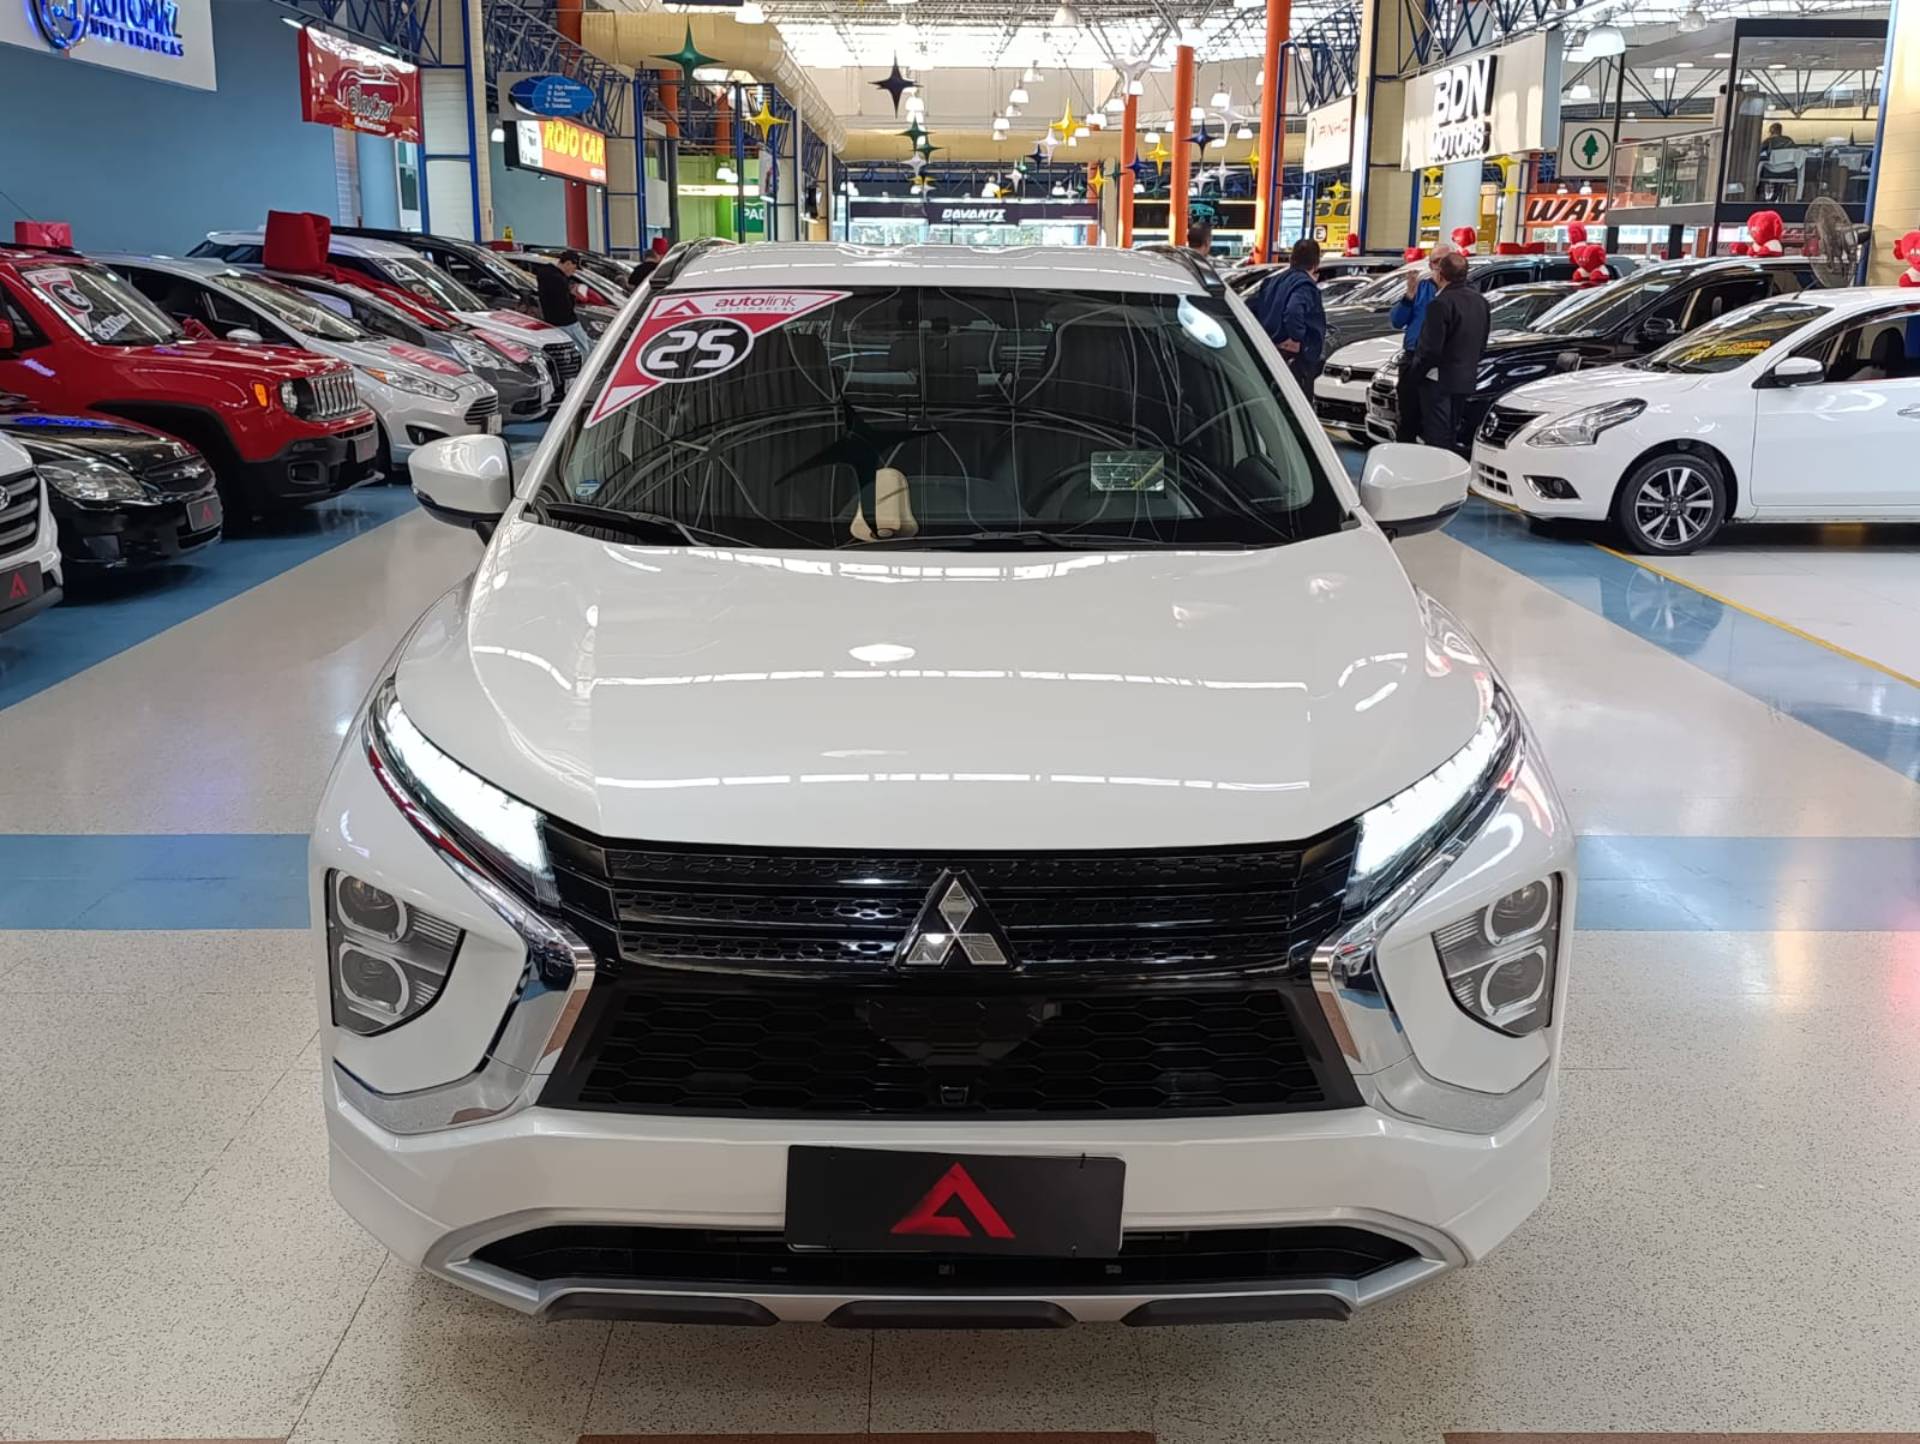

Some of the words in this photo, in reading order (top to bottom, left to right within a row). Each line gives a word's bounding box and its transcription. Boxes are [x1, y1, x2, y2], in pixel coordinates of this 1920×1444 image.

[1432, 55, 1497, 128] BDN
[543, 120, 580, 159] ROJO
[581, 132, 605, 166] CAR
[714, 295, 798, 307] autolink
[646, 328, 738, 370] 25
